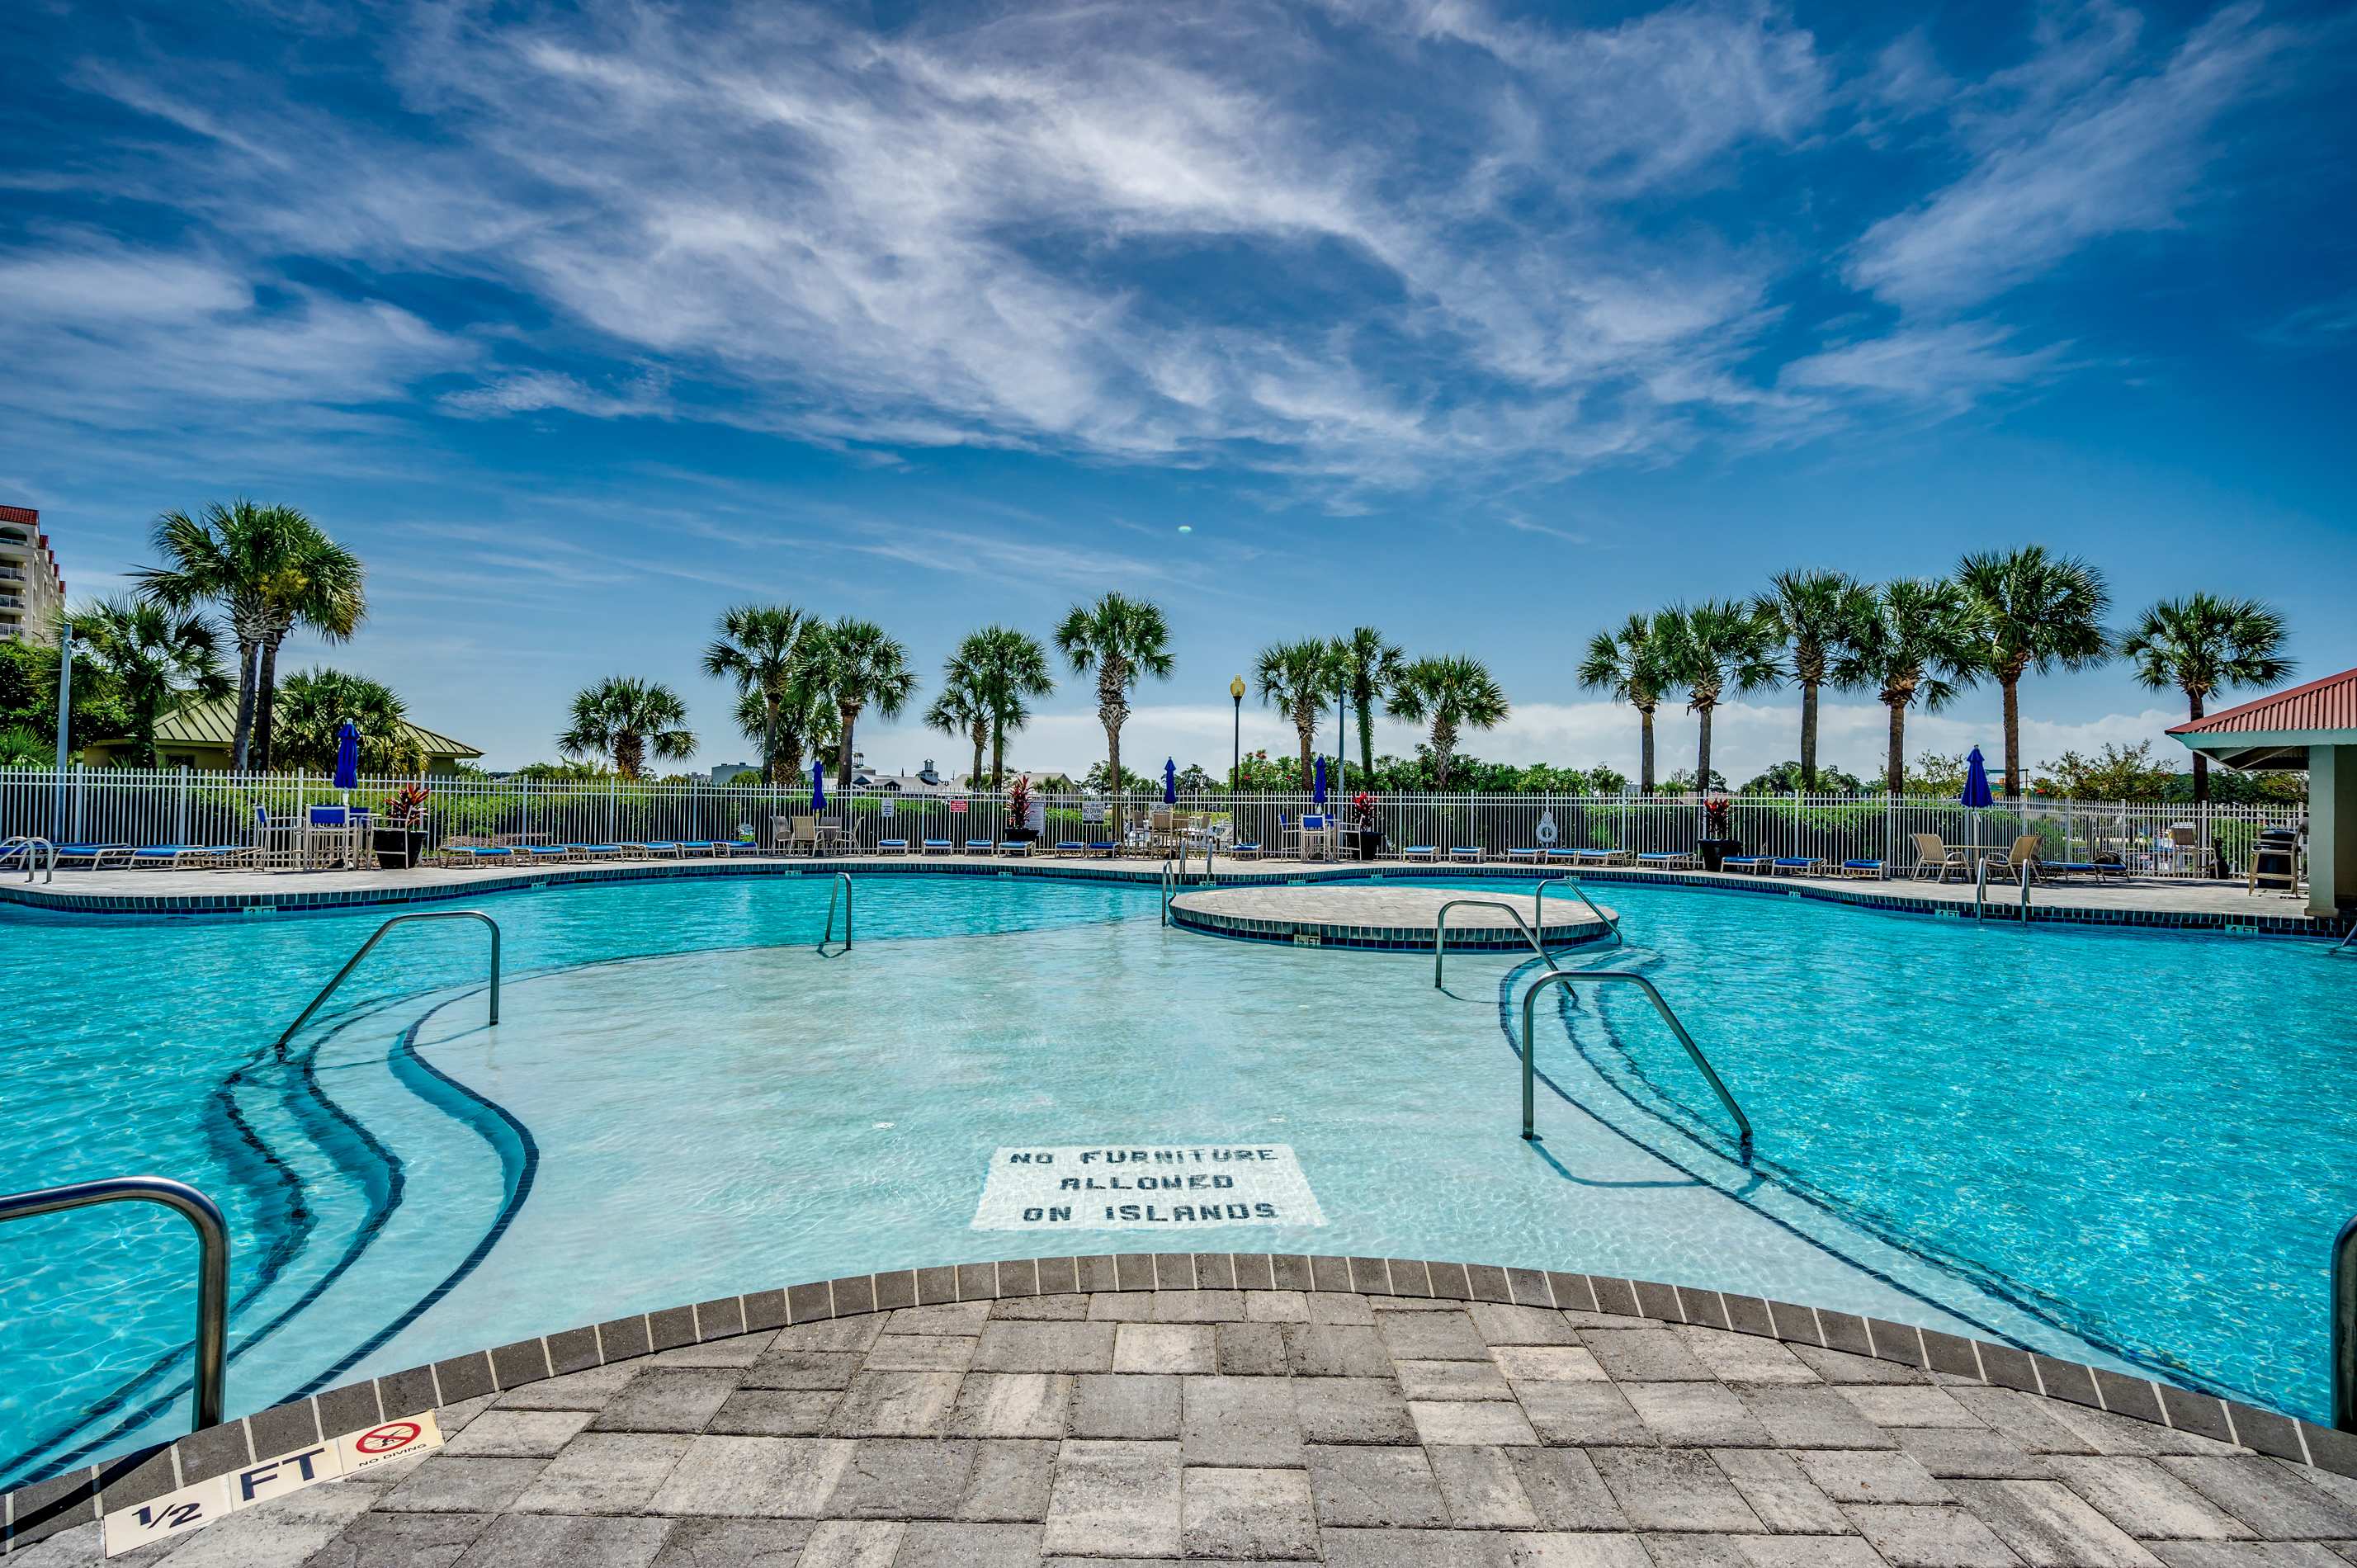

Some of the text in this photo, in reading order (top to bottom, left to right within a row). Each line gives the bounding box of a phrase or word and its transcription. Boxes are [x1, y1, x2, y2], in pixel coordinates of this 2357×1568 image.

[1009, 1148, 1278, 1164] NO FURNITURE
[1060, 1174, 1234, 1190] ALLOWED
[1023, 1202, 1278, 1221] ON ISLANDS
[359, 1443, 427, 1466] NO DIVING
[131, 1448, 325, 1530] 1/2 FT
